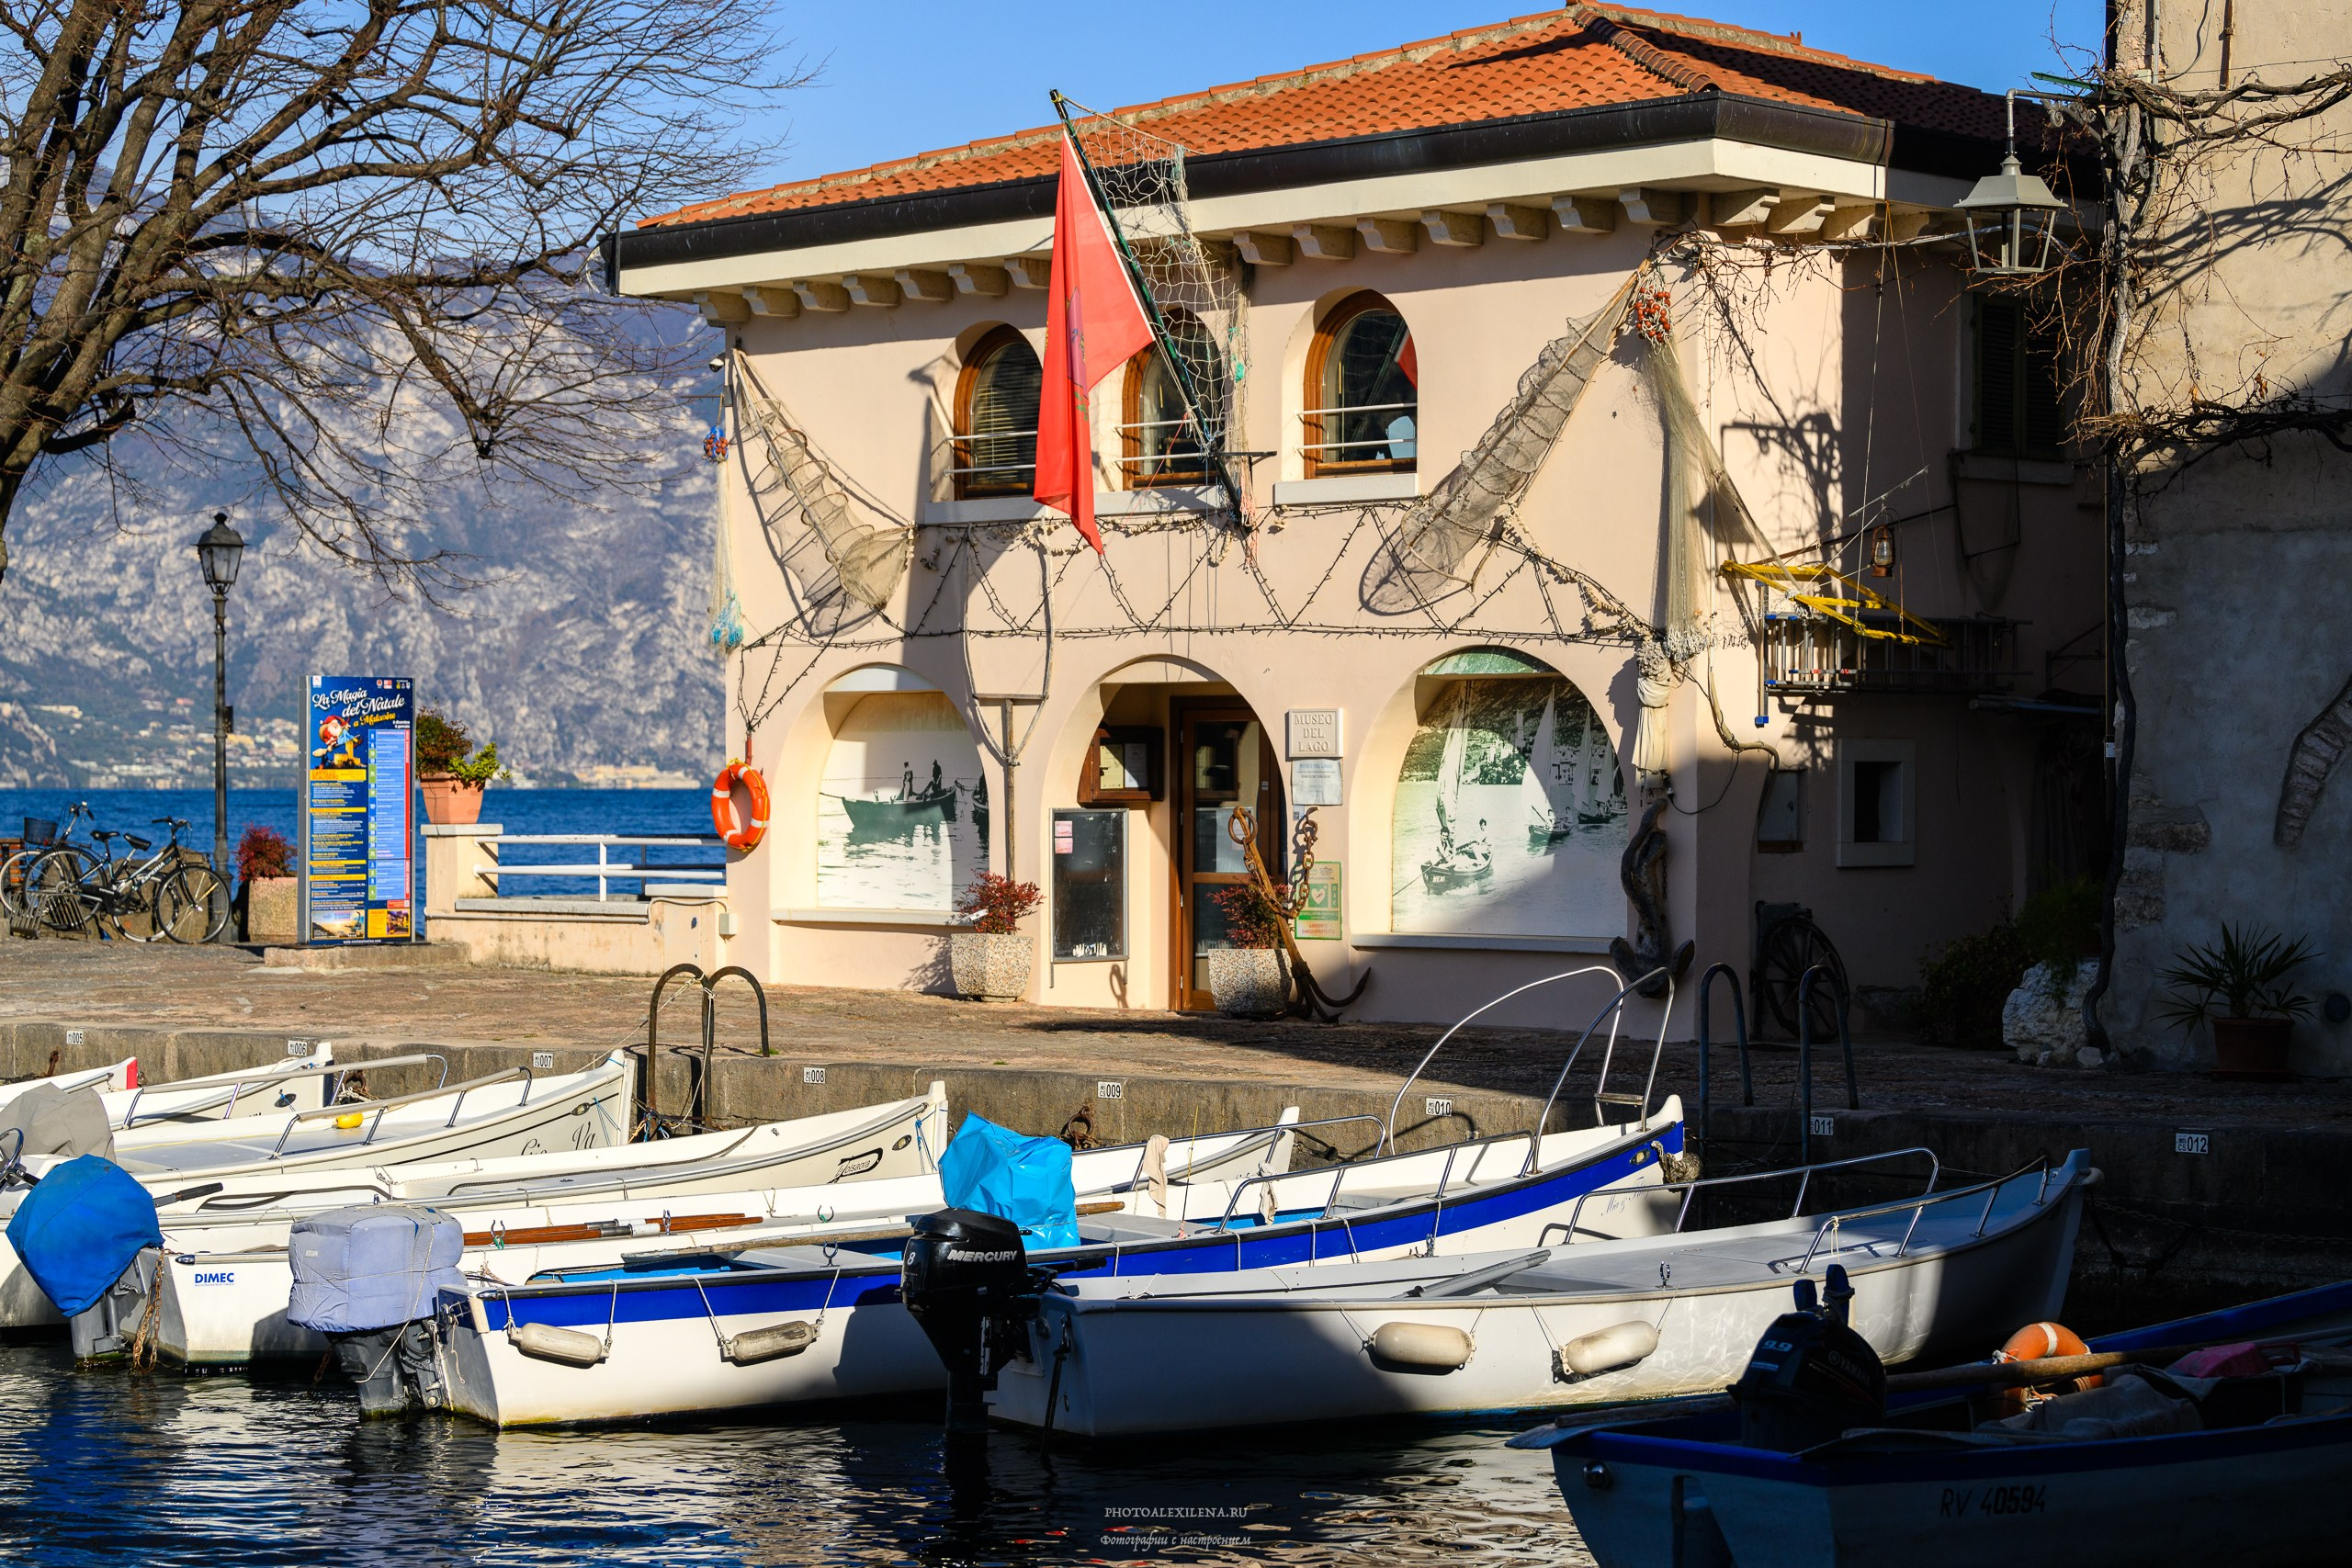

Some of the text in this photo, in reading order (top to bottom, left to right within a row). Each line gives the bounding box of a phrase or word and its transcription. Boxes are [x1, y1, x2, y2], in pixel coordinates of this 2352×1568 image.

[312, 687, 368, 710] La Magia
[342, 694, 404, 717] del Natale
[1295, 714, 1332, 725] MUSEO
[1303, 728, 1324, 739] DEL
[1298, 741, 1330, 752] LAGO
[73, 1032, 83, 1044] 005
[294, 1043, 307, 1055] 006
[539, 1055, 552, 1066] 007
[810, 1069, 825, 1082] 008
[1106, 1084, 1121, 1098] 009
[1435, 1100, 1451, 1116] 010
[1814, 1119, 1831, 1134] 011
[2187, 1135, 2207, 1153] 012
[907, 1248, 1018, 1266] 8 MERCURY
[195, 1272, 234, 1284] DIMEC
[1761, 1339, 1793, 1353] 9.9
[1840, 1355, 1871, 1388] YAMAHA
[1939, 1483, 2047, 1517] RV 40594
